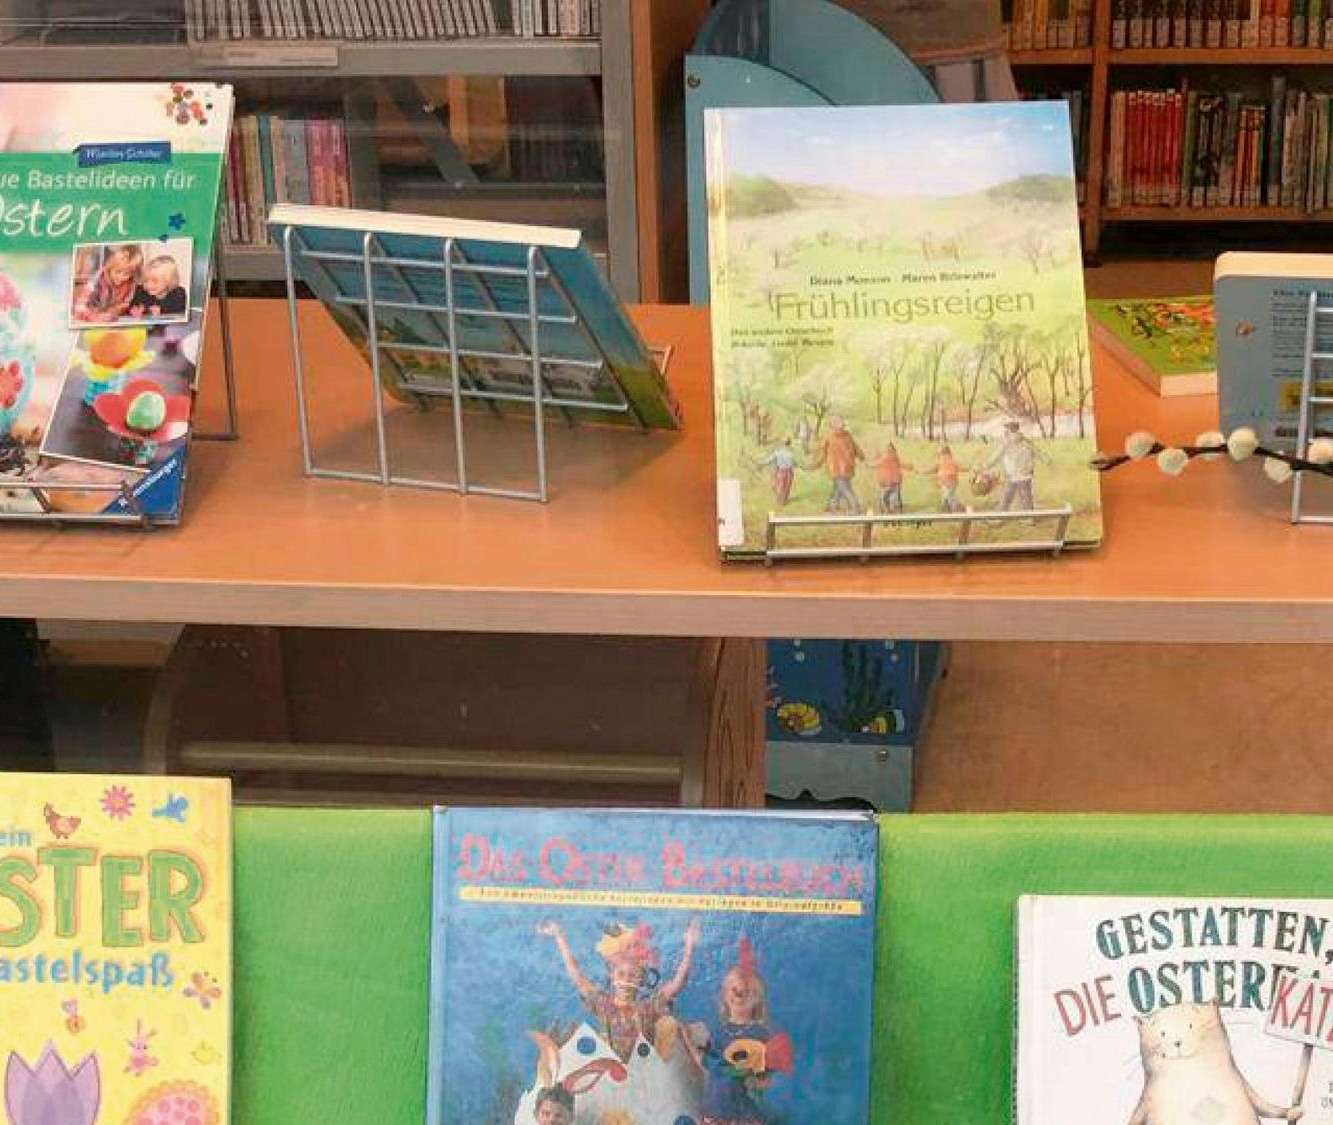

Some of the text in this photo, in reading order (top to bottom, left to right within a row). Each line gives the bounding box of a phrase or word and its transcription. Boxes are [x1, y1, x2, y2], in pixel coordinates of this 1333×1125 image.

[28, 169, 156, 190] Bastelideen
[162, 169, 197, 189] für
[810, 275, 843, 286] Diana
[775, 288, 1035, 325] Frühlingsreigen
[1054, 974, 1122, 1037] DIE
